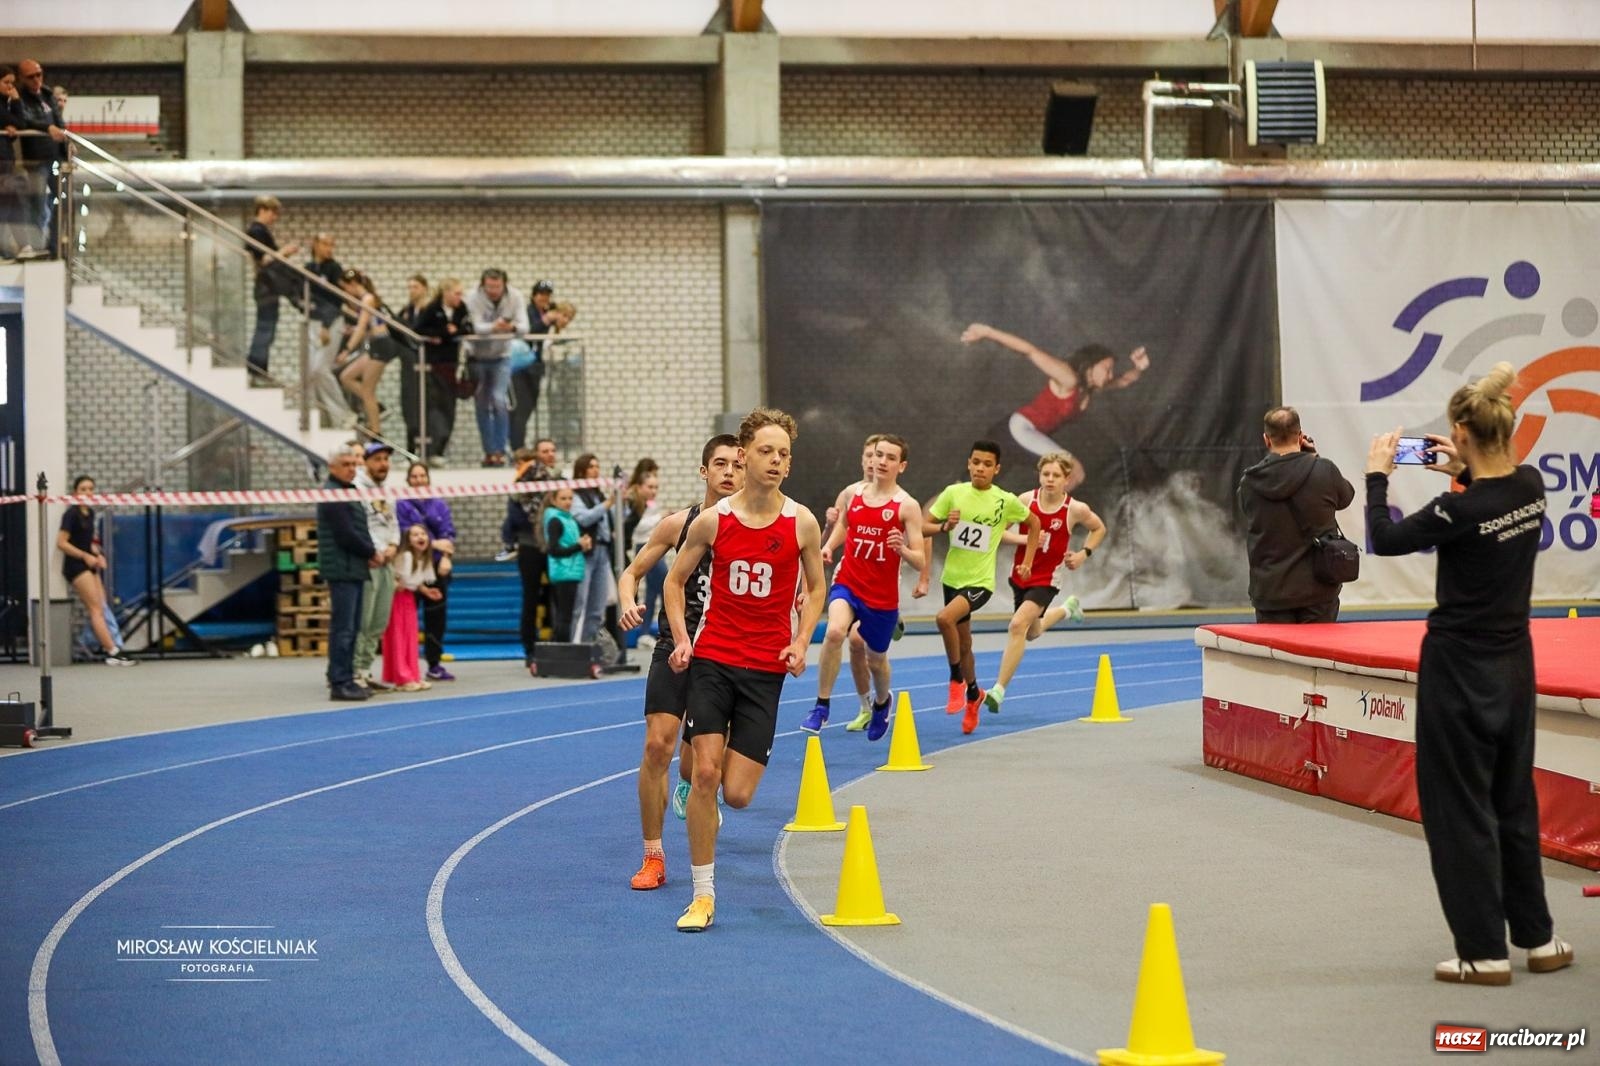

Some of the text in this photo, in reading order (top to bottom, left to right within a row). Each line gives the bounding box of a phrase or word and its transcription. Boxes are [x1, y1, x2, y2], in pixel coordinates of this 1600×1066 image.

[106, 99, 126, 112] 17
[857, 525, 883, 536] PIAST
[958, 526, 983, 548] 42
[853, 538, 886, 562] 771
[729, 559, 773, 598] 63
[1369, 694, 1406, 721] polanik
